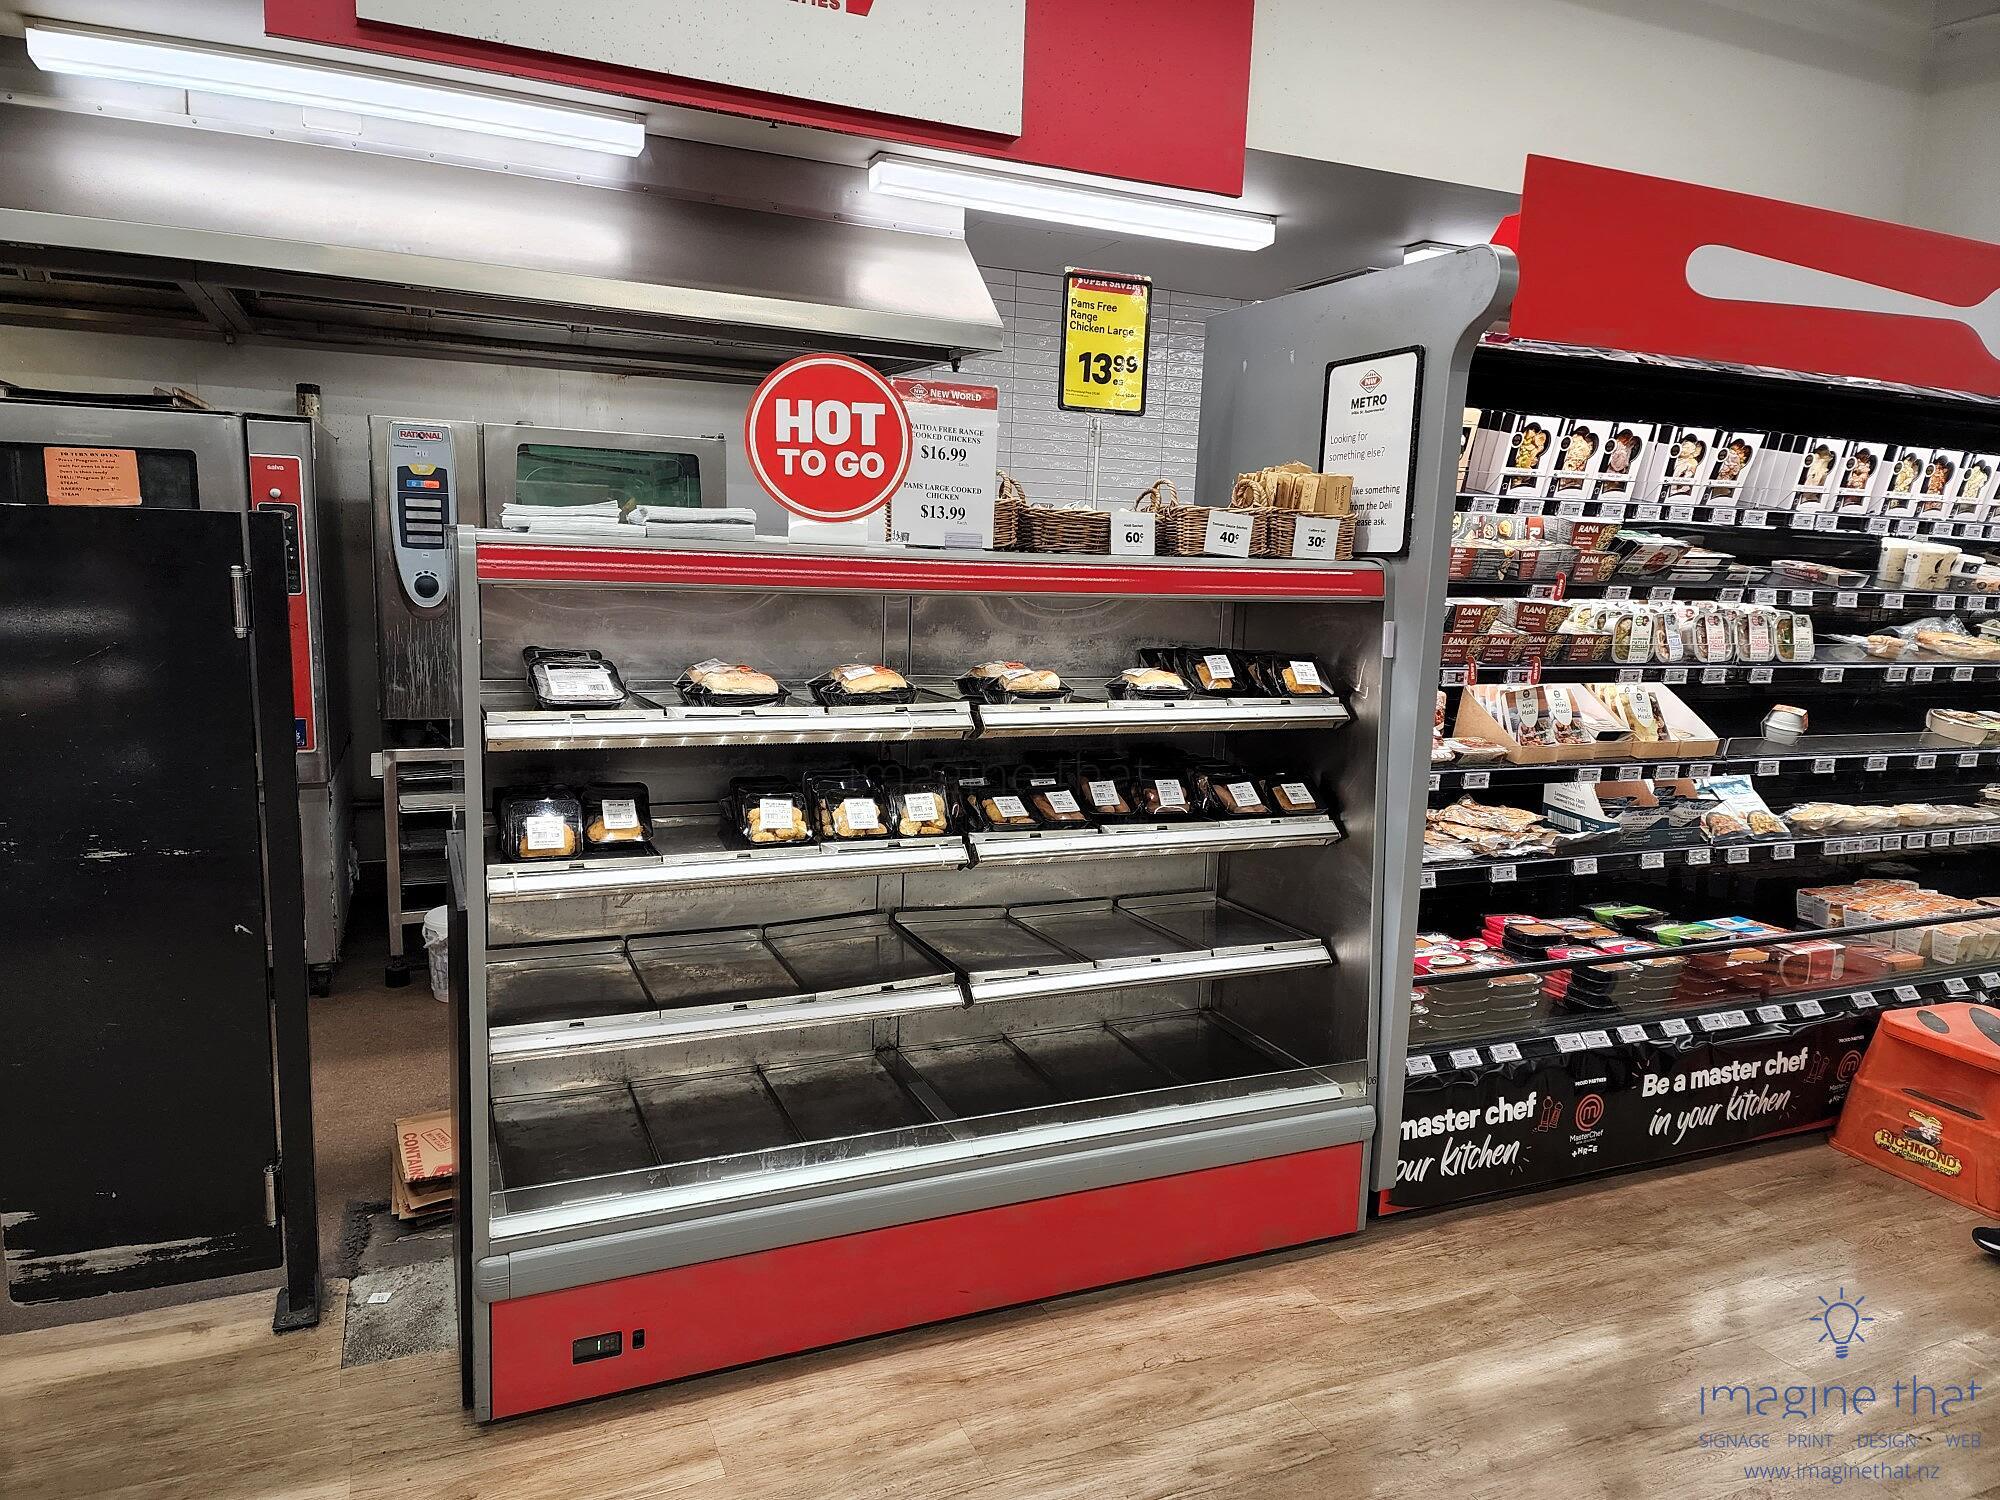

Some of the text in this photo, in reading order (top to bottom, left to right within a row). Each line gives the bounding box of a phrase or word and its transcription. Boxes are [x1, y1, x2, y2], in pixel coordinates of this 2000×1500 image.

[1071, 298, 1117, 312] Pams Free
[1070, 310, 1098, 322] Range
[1070, 320, 1134, 338] Chicken Large
[930, 389, 982, 402] NEW WORLD
[1350, 394, 1388, 410] METRO
[776, 398, 886, 446] HOT
[400, 430, 442, 440] RATIONAL
[939, 426, 957, 434] FREE
[959, 428, 984, 437] RANGE
[913, 431, 981, 445] OOKED CHICKENS
[1330, 431, 1369, 445] Looking for
[921, 445, 967, 463] $16.99
[1329, 446, 1386, 462] something else?
[777, 448, 885, 479] TO GO
[925, 484, 950, 492] LARGE
[951, 486, 982, 495] COOKED
[1352, 485, 1401, 496] like something
[926, 492, 960, 500] CHICKEN
[1366, 501, 1378, 510] the
[1379, 500, 1393, 510] Deli
[920, 504, 966, 521] $13.99
[1356, 518, 1387, 527] ease ask.
[1578, 525, 1599, 533] RANA
[1126, 532, 1144, 543] 60¢
[1220, 532, 1240, 544] 40¢
[1308, 536, 1326, 547] 30¢
[1580, 556, 1599, 564] RANA
[1461, 607, 1481, 616] RANA
[1523, 605, 1547, 616] RANA
[1448, 637, 1468, 645] RANA
[1528, 636, 1547, 644] RANA
[1575, 637, 1594, 645] RANA
[1642, 1047, 1809, 1098] Be a master chef
[1400, 1091, 1538, 1141] master chef
[1648, 1084, 1792, 1146] in your kitchen
[1570, 1129, 1604, 1143] MasterChef
[1880, 1130, 1958, 1169] RICHMOND
[1396, 1134, 1520, 1182] our kitchen
